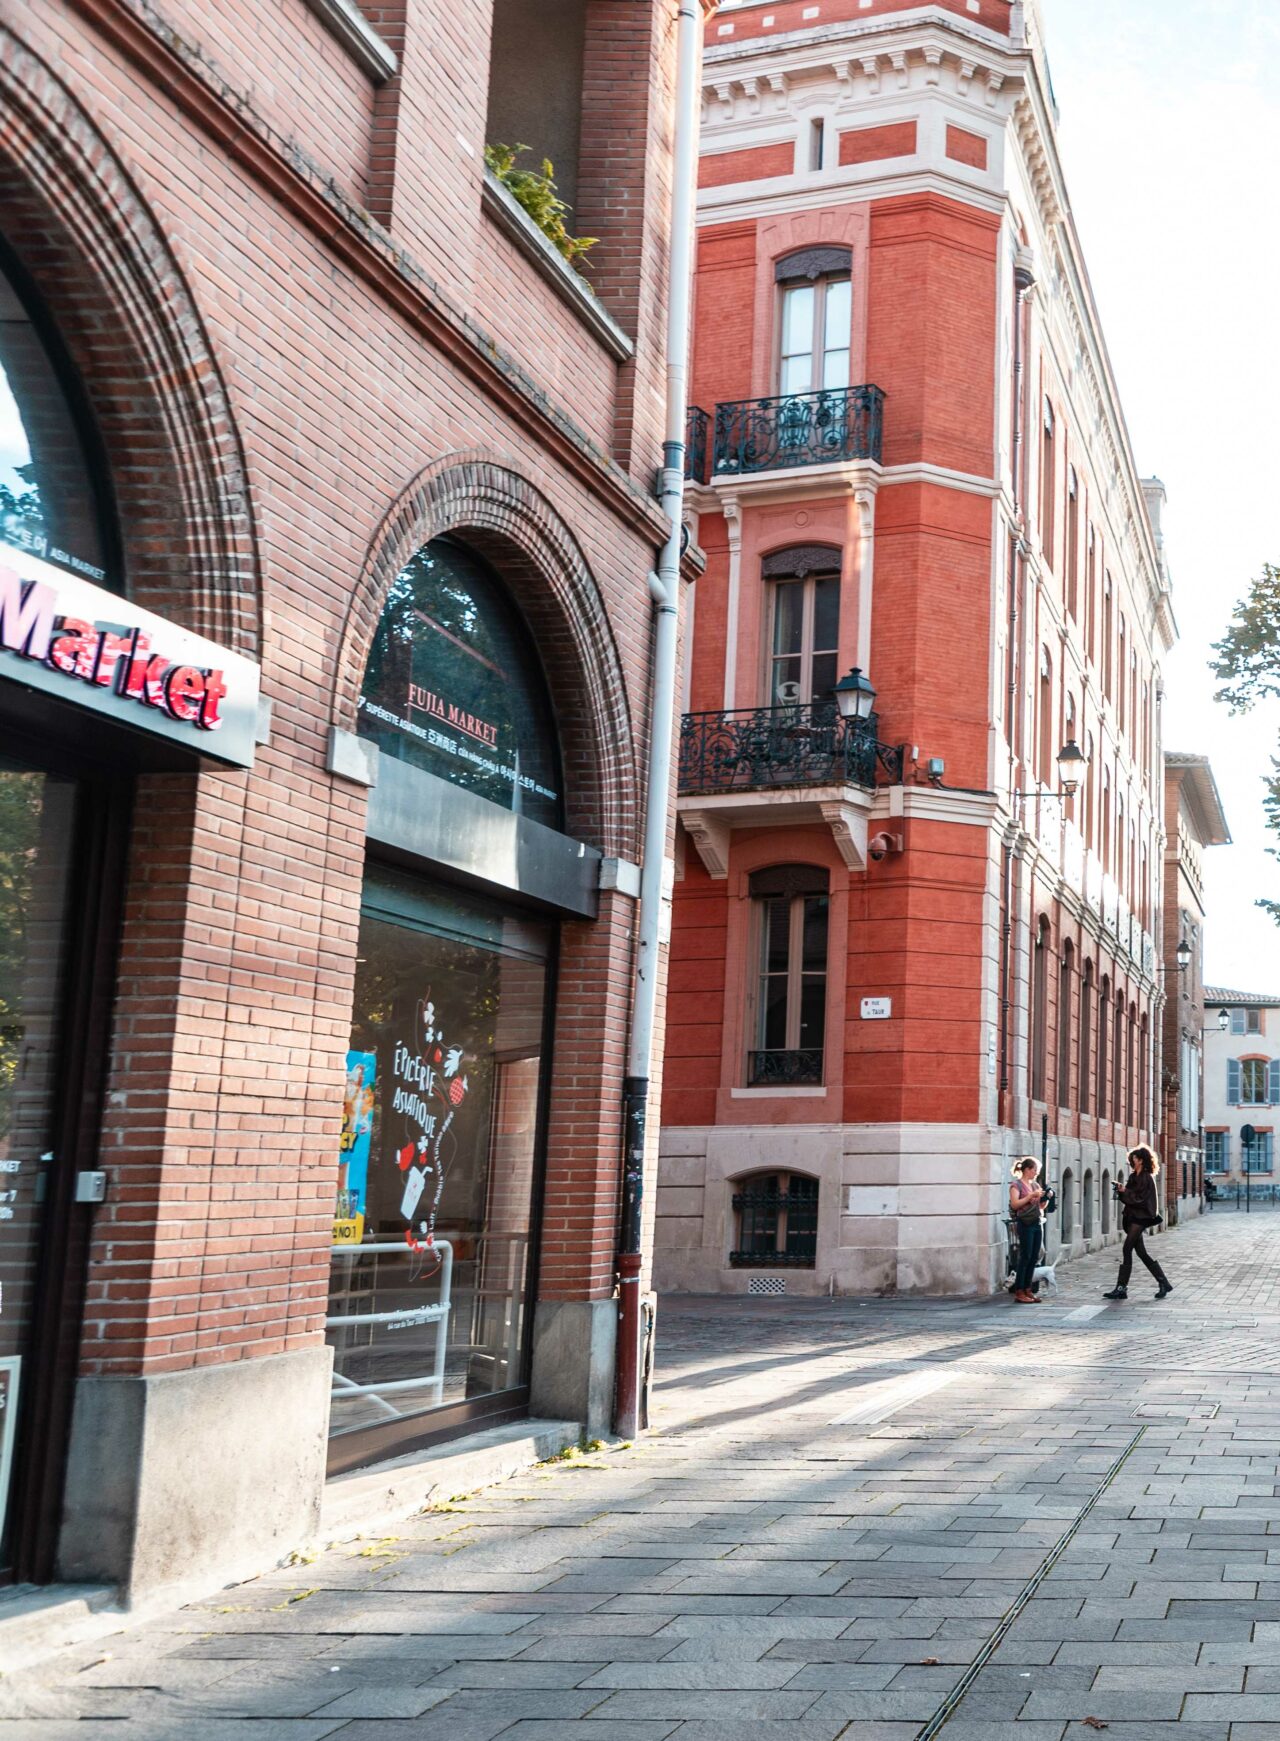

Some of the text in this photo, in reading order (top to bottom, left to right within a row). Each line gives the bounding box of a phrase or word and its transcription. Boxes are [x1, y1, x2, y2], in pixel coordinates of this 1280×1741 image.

[50, 547, 71, 565] ASIA
[71, 556, 107, 581] MARKET
[0, 567, 228, 731] Market
[408, 683, 498, 744] FUJIA MARKET
[393, 1040, 437, 1097] ÉPICERIE
[392, 1086, 437, 1139] ASIATIQUE
[338, 1226, 357, 1239] NO.1
